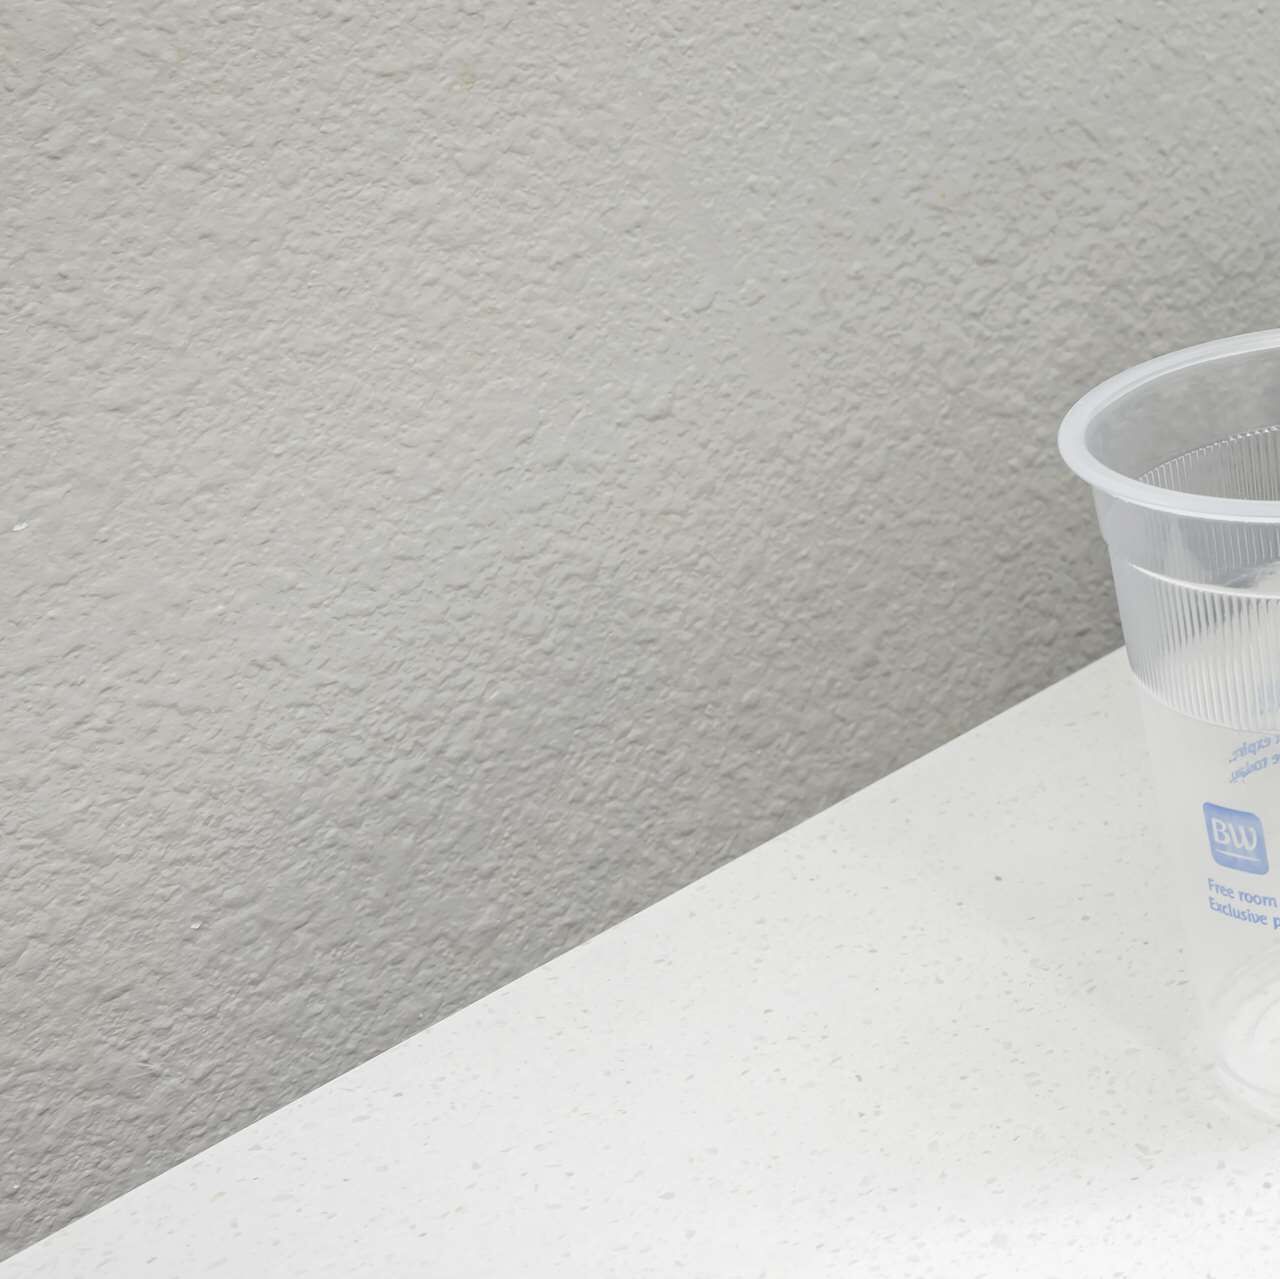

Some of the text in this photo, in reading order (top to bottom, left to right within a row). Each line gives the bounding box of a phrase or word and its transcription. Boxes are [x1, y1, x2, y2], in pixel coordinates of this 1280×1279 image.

[1211, 817, 1258, 851] BW
[1207, 877, 1235, 899] Free
[1238, 890, 1278, 908] room
[1208, 896, 1268, 926] Exclusive
